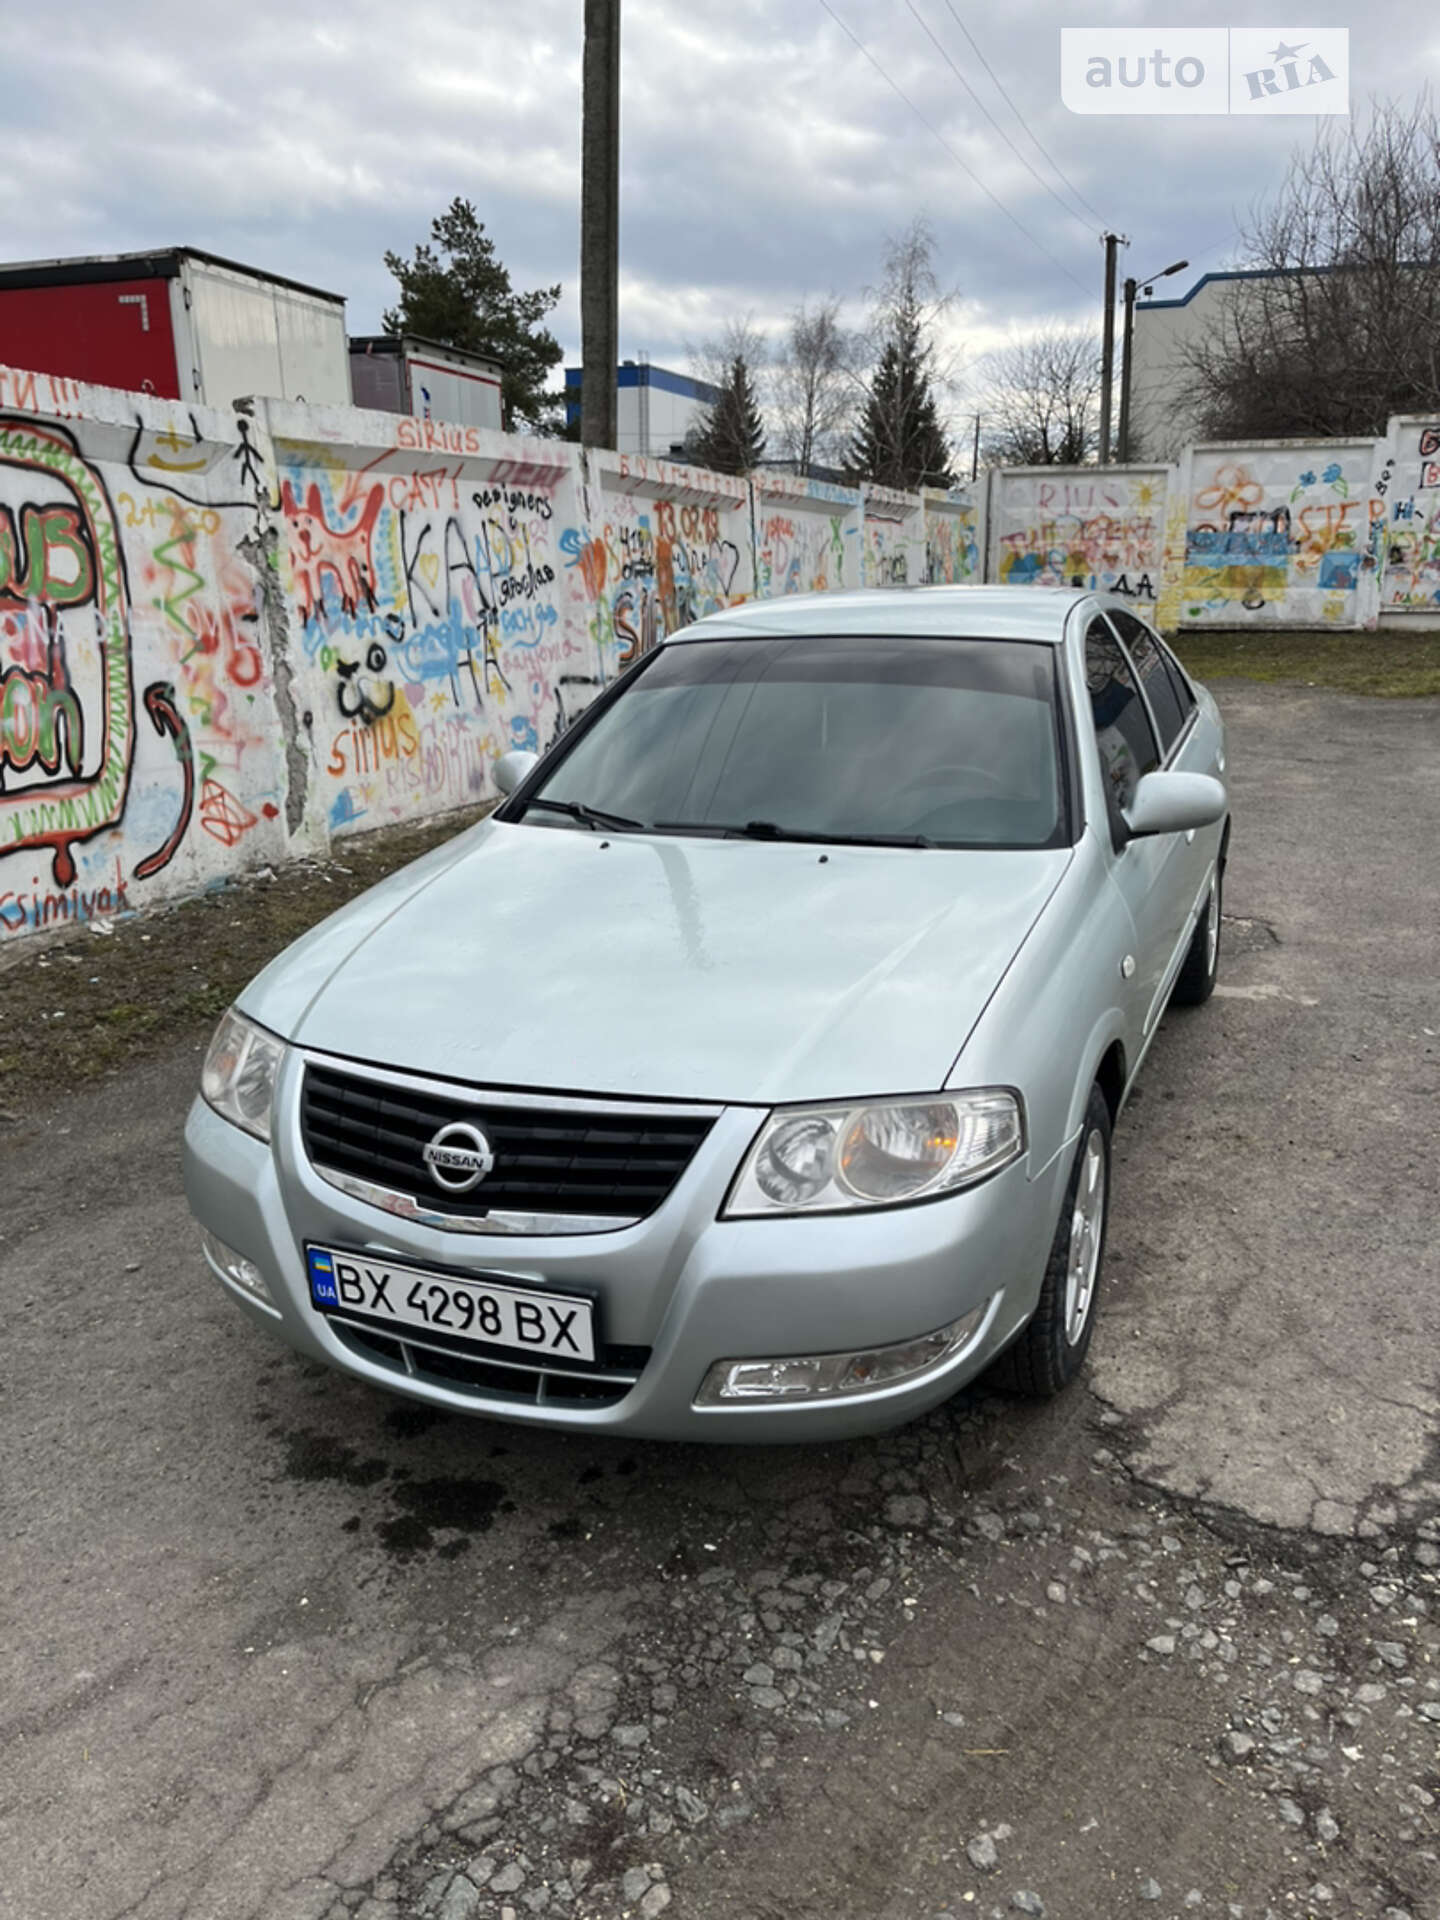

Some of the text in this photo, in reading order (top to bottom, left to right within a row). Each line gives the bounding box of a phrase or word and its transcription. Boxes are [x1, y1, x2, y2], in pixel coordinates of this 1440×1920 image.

[428, 1149, 485, 1169] NISSAN
[317, 1284, 336, 1299] UA
[337, 1263, 580, 1352] BX 4298 BX
